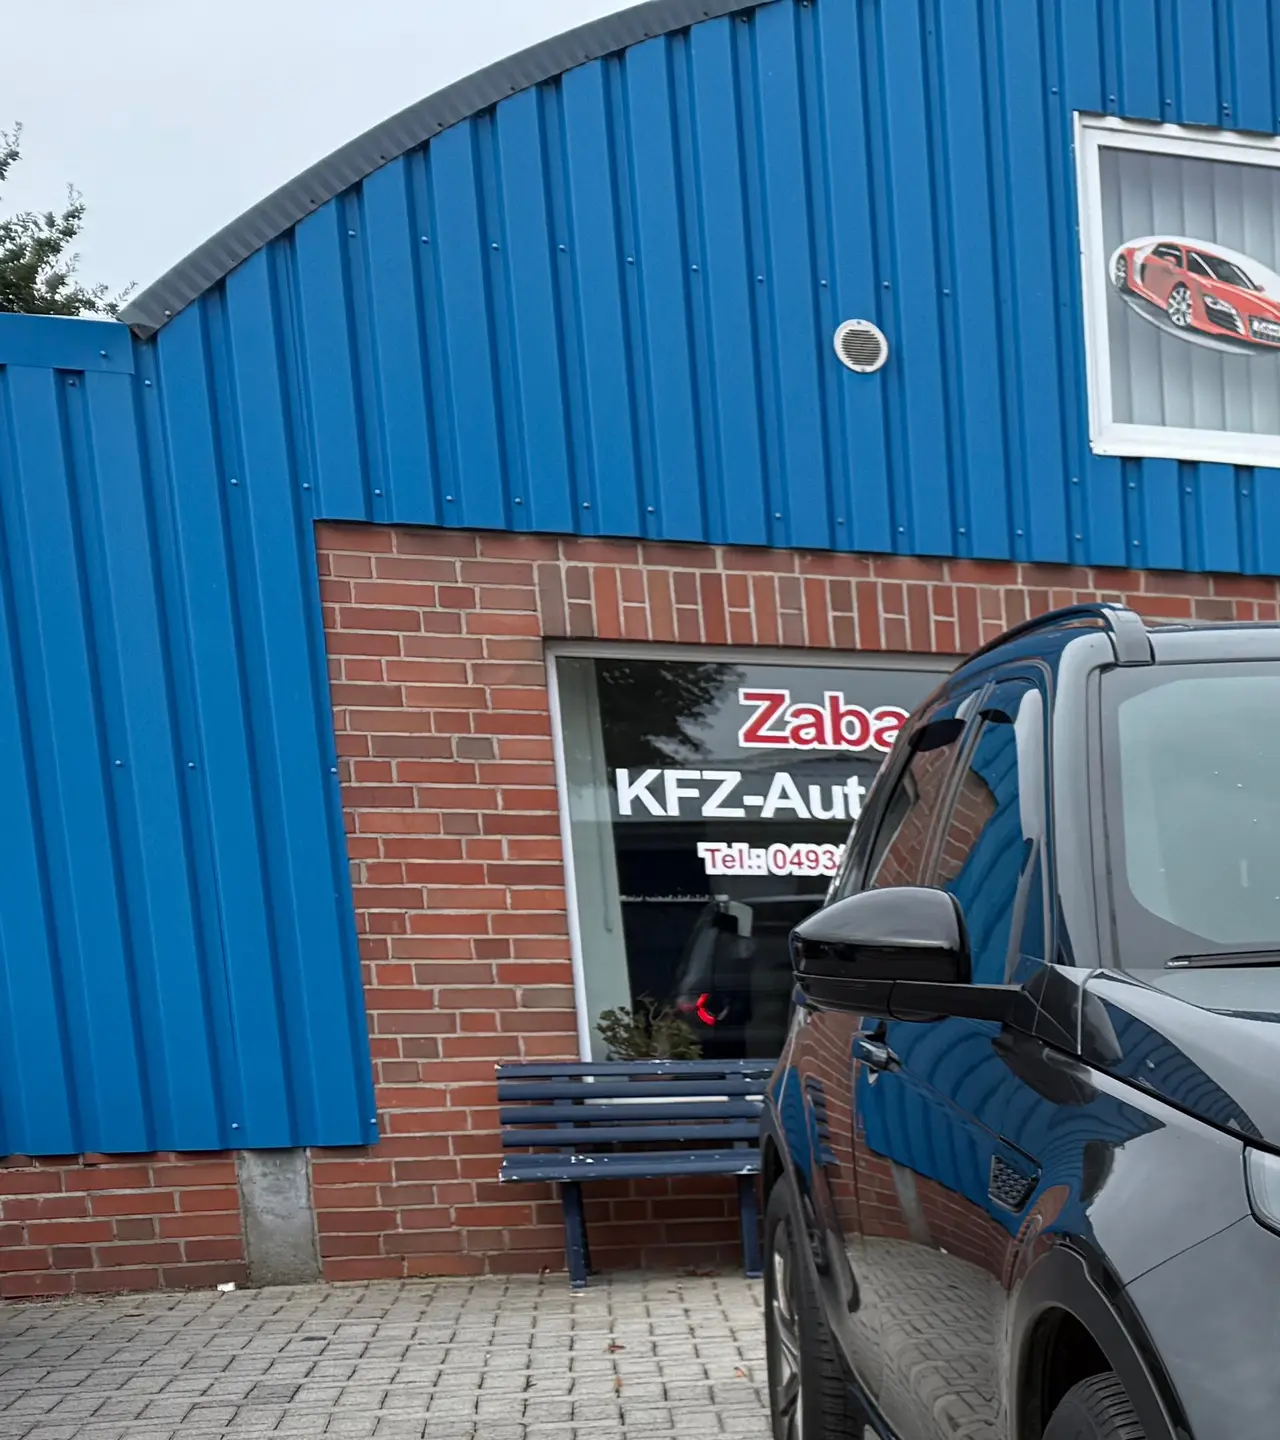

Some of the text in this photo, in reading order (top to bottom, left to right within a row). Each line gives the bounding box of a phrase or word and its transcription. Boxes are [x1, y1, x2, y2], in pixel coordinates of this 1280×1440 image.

[741, 692, 907, 749] Zaba
[616, 768, 866, 820] KFZ-Aut
[704, 848, 842, 872] Tel.: 0493
